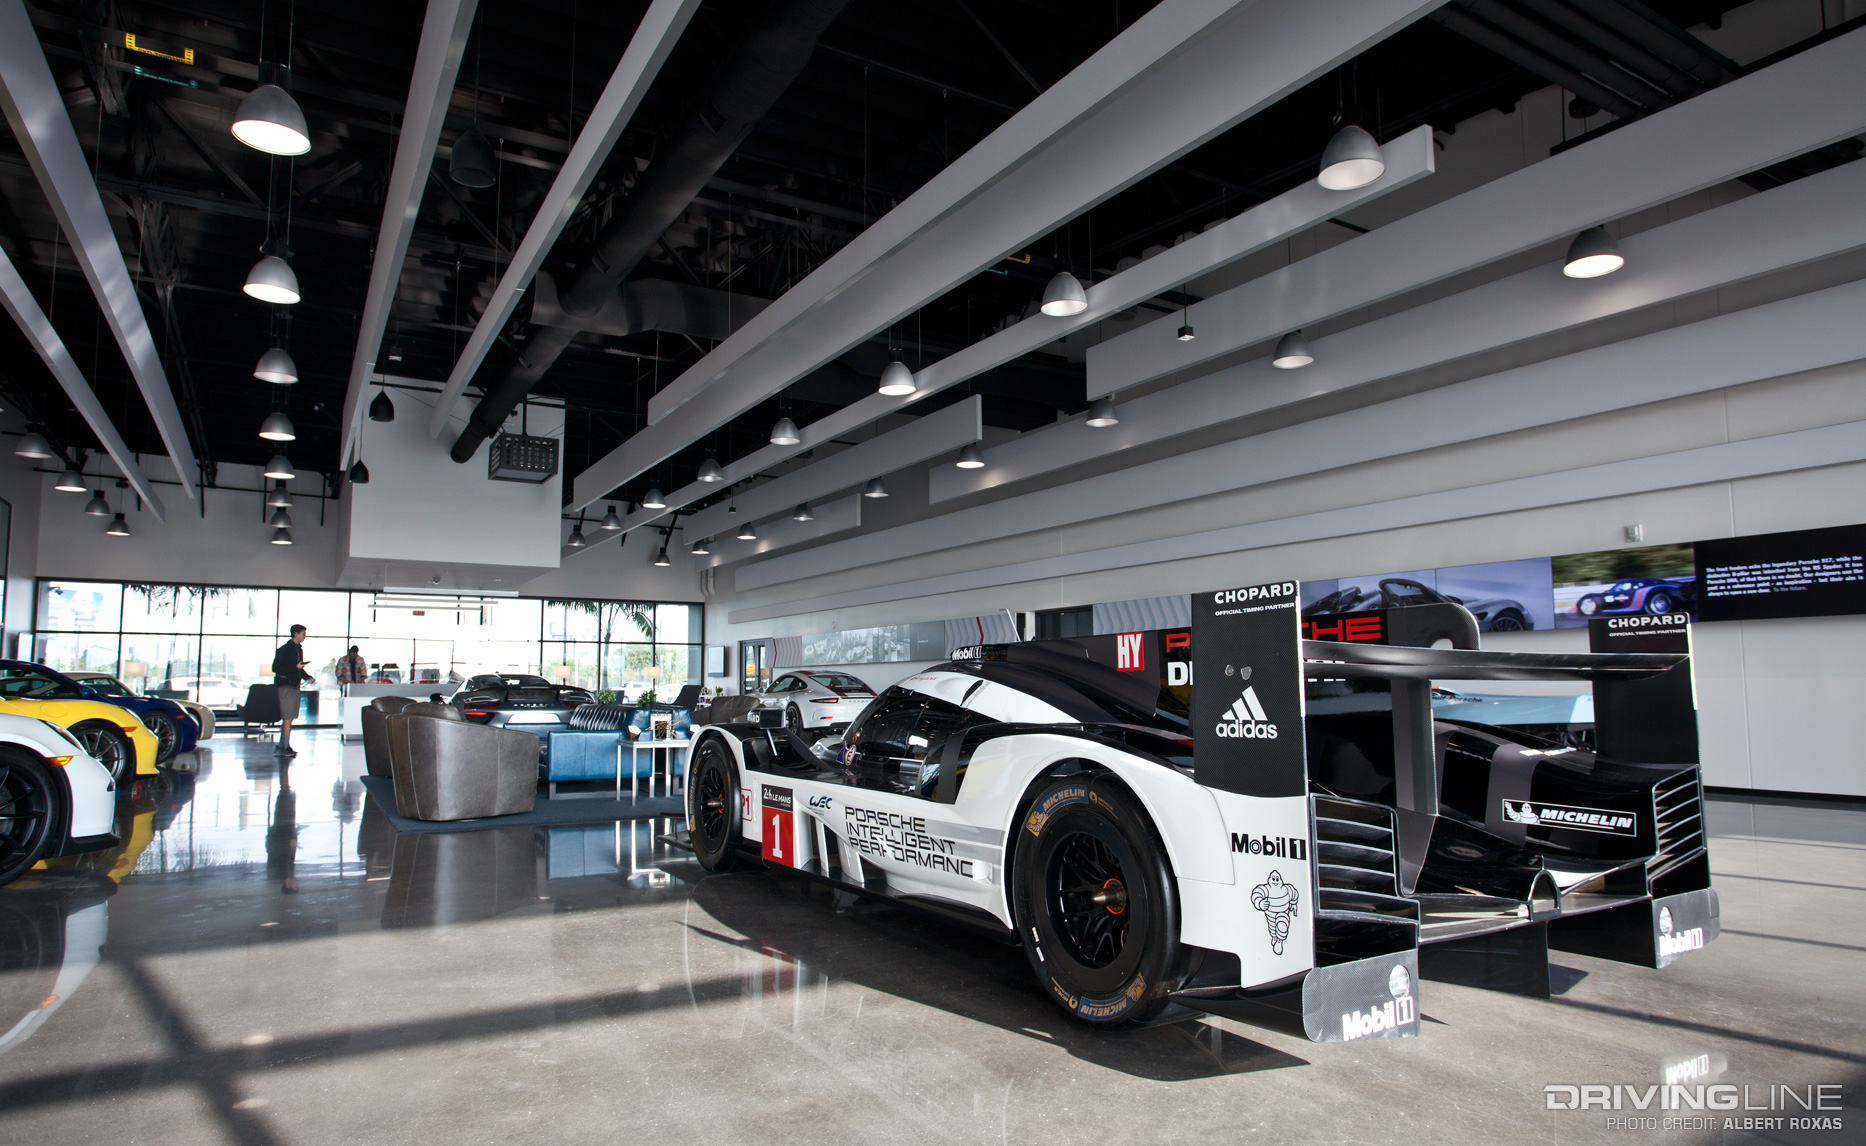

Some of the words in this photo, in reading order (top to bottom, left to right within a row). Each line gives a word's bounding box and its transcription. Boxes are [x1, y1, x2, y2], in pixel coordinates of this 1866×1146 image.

[1214, 582, 1294, 604] CHOPARD
[1608, 615, 1685, 628] CHOPARD
[952, 647, 974, 660] Mobil
[1118, 634, 1142, 668] HY
[1216, 719, 1278, 739] adidas
[810, 796, 832, 809] WEC
[1042, 788, 1084, 811] MICHELIN
[845, 806, 925, 833] PORSCHE
[1539, 808, 1633, 828] MICHELIN
[772, 814, 782, 858] 1
[846, 822, 955, 855] INTELLIGENT
[1231, 832, 1286, 858] Mobil
[1289, 838, 1306, 860] 1
[1659, 930, 1691, 956] Mobil
[1692, 928, 1703, 949] 1
[1081, 998, 1126, 1016] MICHELIN
[1342, 1000, 1395, 1041] Mobil
[1396, 996, 1414, 1025] 1
